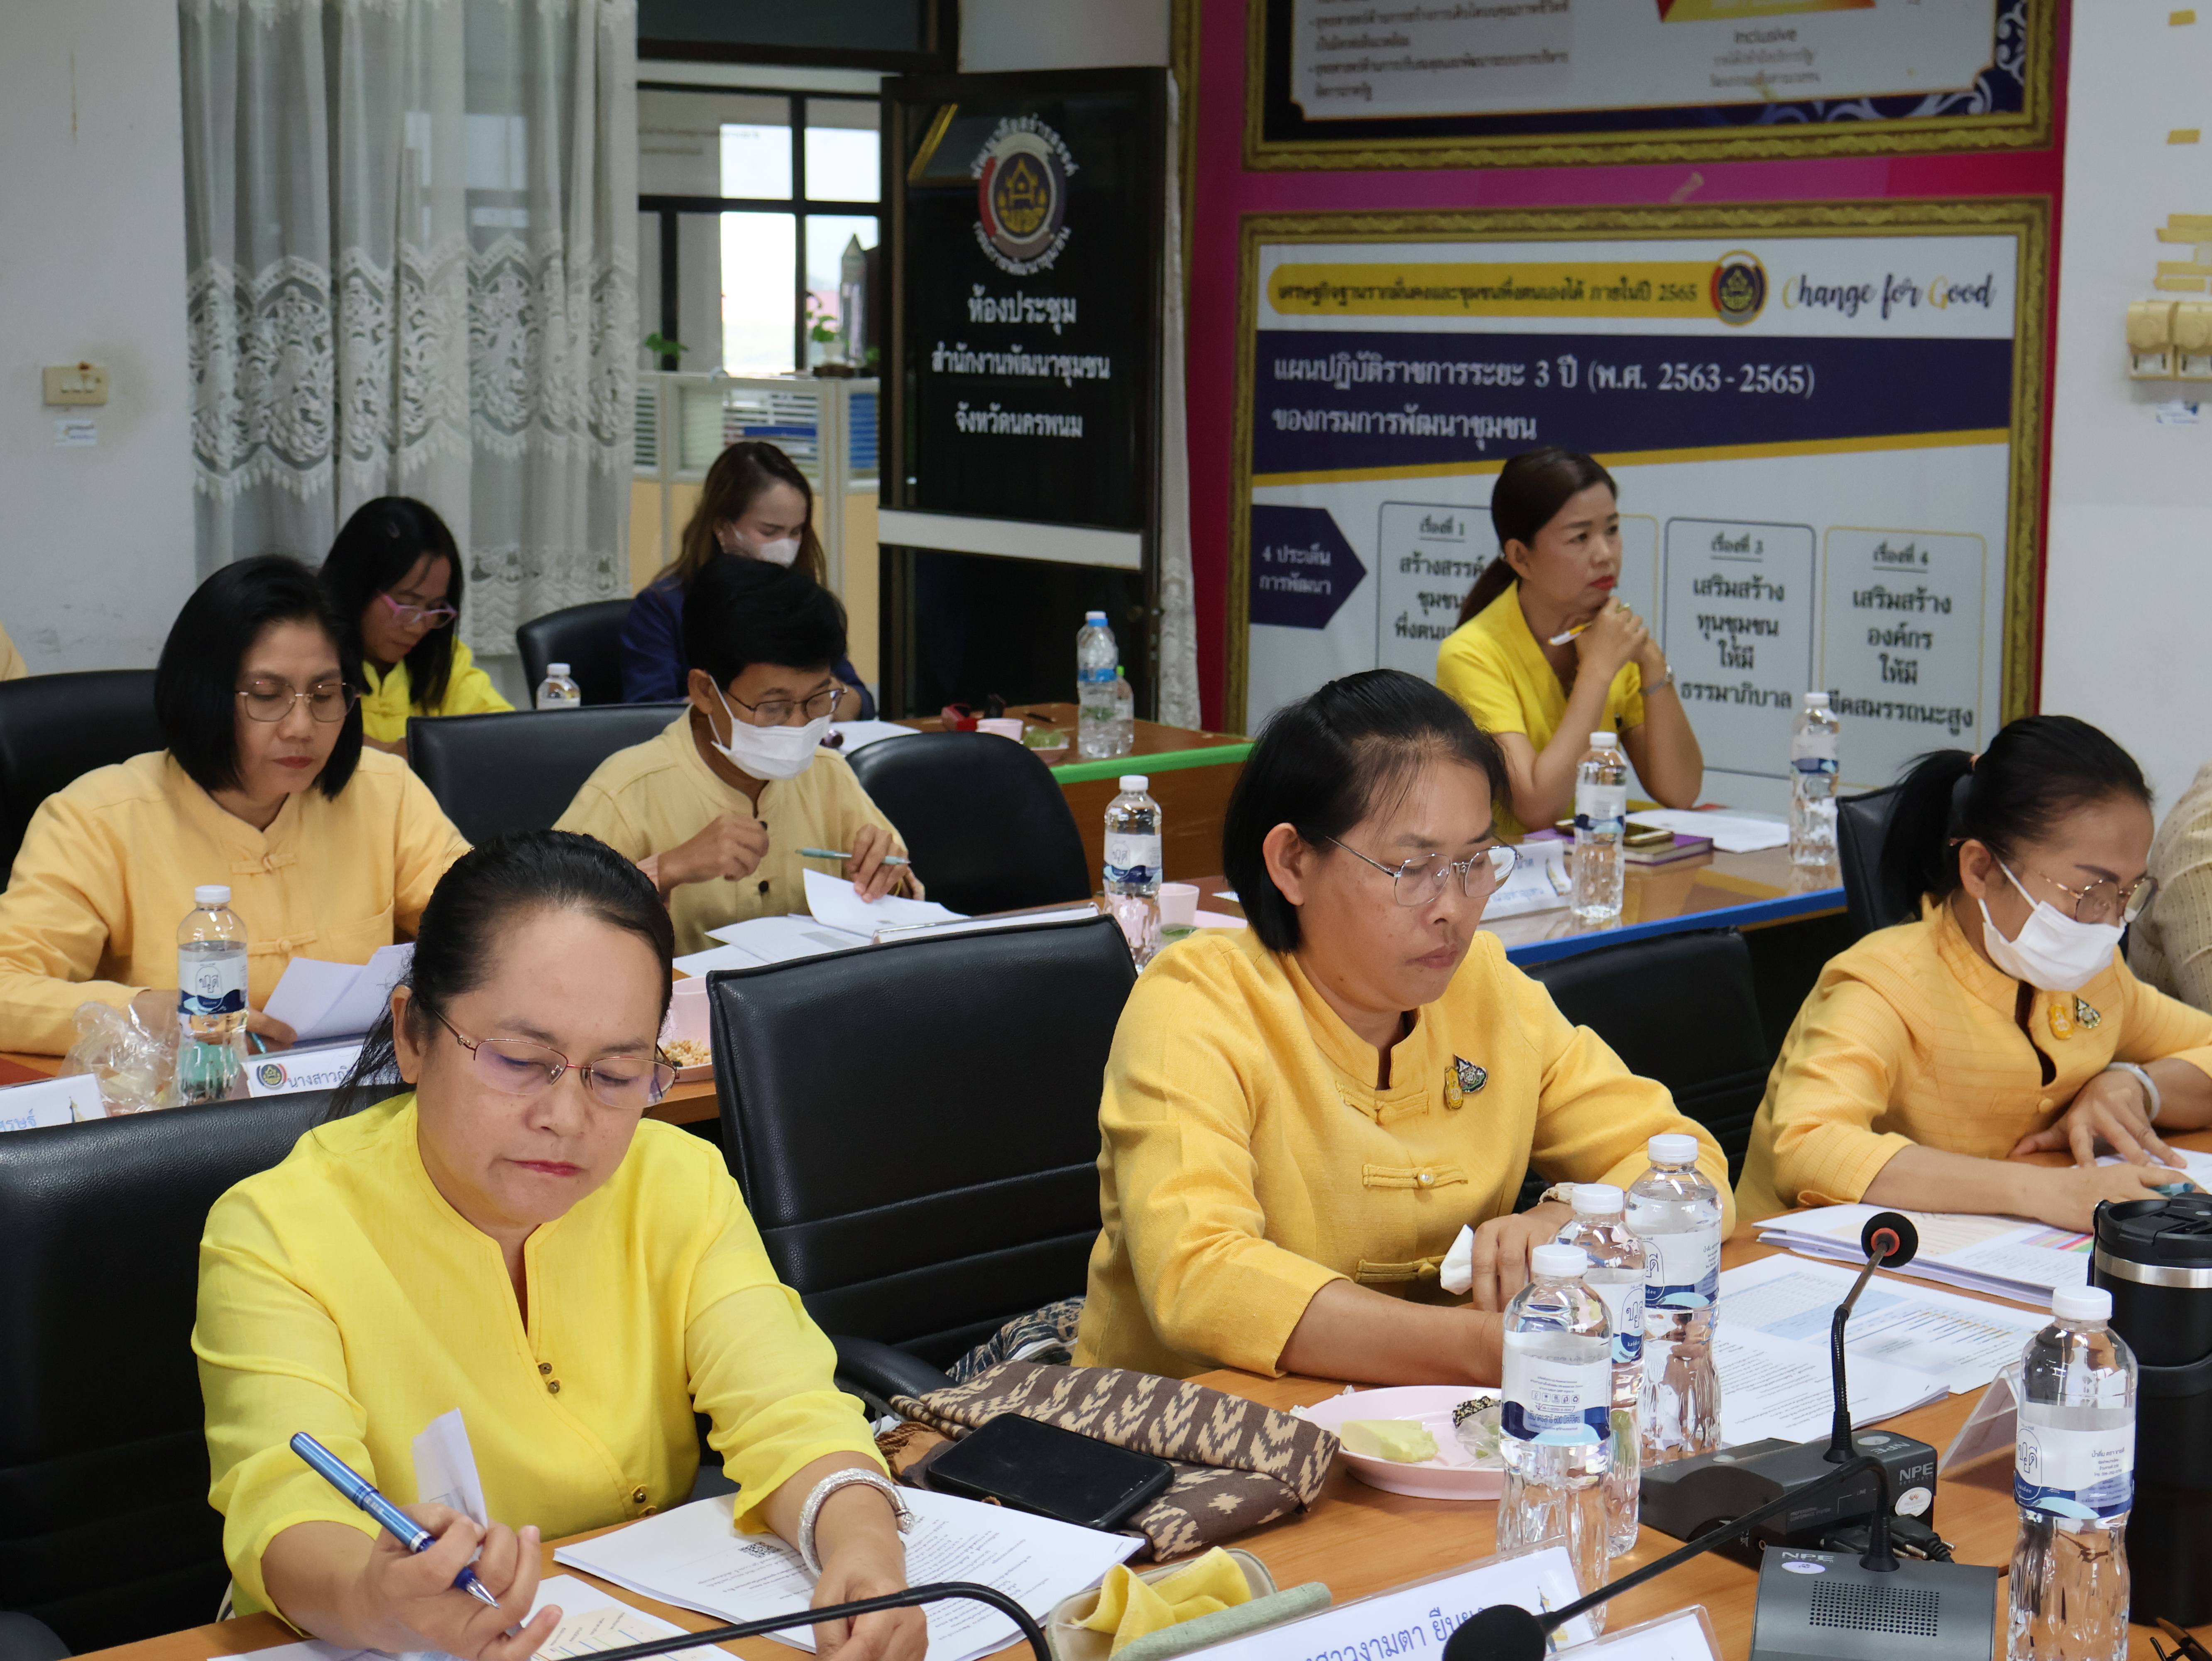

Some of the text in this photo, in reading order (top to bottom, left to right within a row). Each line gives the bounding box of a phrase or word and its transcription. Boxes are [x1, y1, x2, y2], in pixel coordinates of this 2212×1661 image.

[1657, 284, 1697, 302] 2565
[1782, 272, 1994, 320] Change for Good
[968, 283, 1077, 335] ห้องประชุม
[932, 341, 1111, 388] สำนักงานพัฒนาชุมชน
[1274, 351, 1527, 390] แผนปฏิบัติราชการระยะ
[1535, 360, 1549, 387] 3
[1559, 355, 1578, 387] ปี
[1588, 361, 1647, 394] (พ.ศ.
[955, 401, 1082, 437] จังหวัดนครพนม
[1272, 404, 1537, 451] ของกรมการพัฒนาชุมชน
[1419, 514, 1465, 536] เรื่องที่ 1
[1262, 542, 1331, 566] 4 ประเด็น
[1711, 531, 1763, 554] เรื่องที่ 3
[1873, 539, 1929, 566] เรื่องที่ 4
[1259, 572, 1331, 595] การพัฒนา
[1692, 574, 1785, 602] เสริมสร้าง
[1852, 584, 1952, 615] เสริมสร้าง
[1697, 612, 1779, 642] ทุนชุมชน
[1867, 622, 1933, 650] องค์กร
[1718, 639, 1754, 669] ให้มี
[1879, 653, 1917, 685] ให้มี
[1680, 679, 1792, 709] ธรรมาภิบาล
[1554, 1415, 1562, 1424] 600
[1870, 1442, 1910, 1454] NPE
[2092, 1449, 2105, 1458] น้ำดื่ม
[1899, 1462, 1934, 1481] NPE
[1781, 1551, 1835, 1561] NPE
